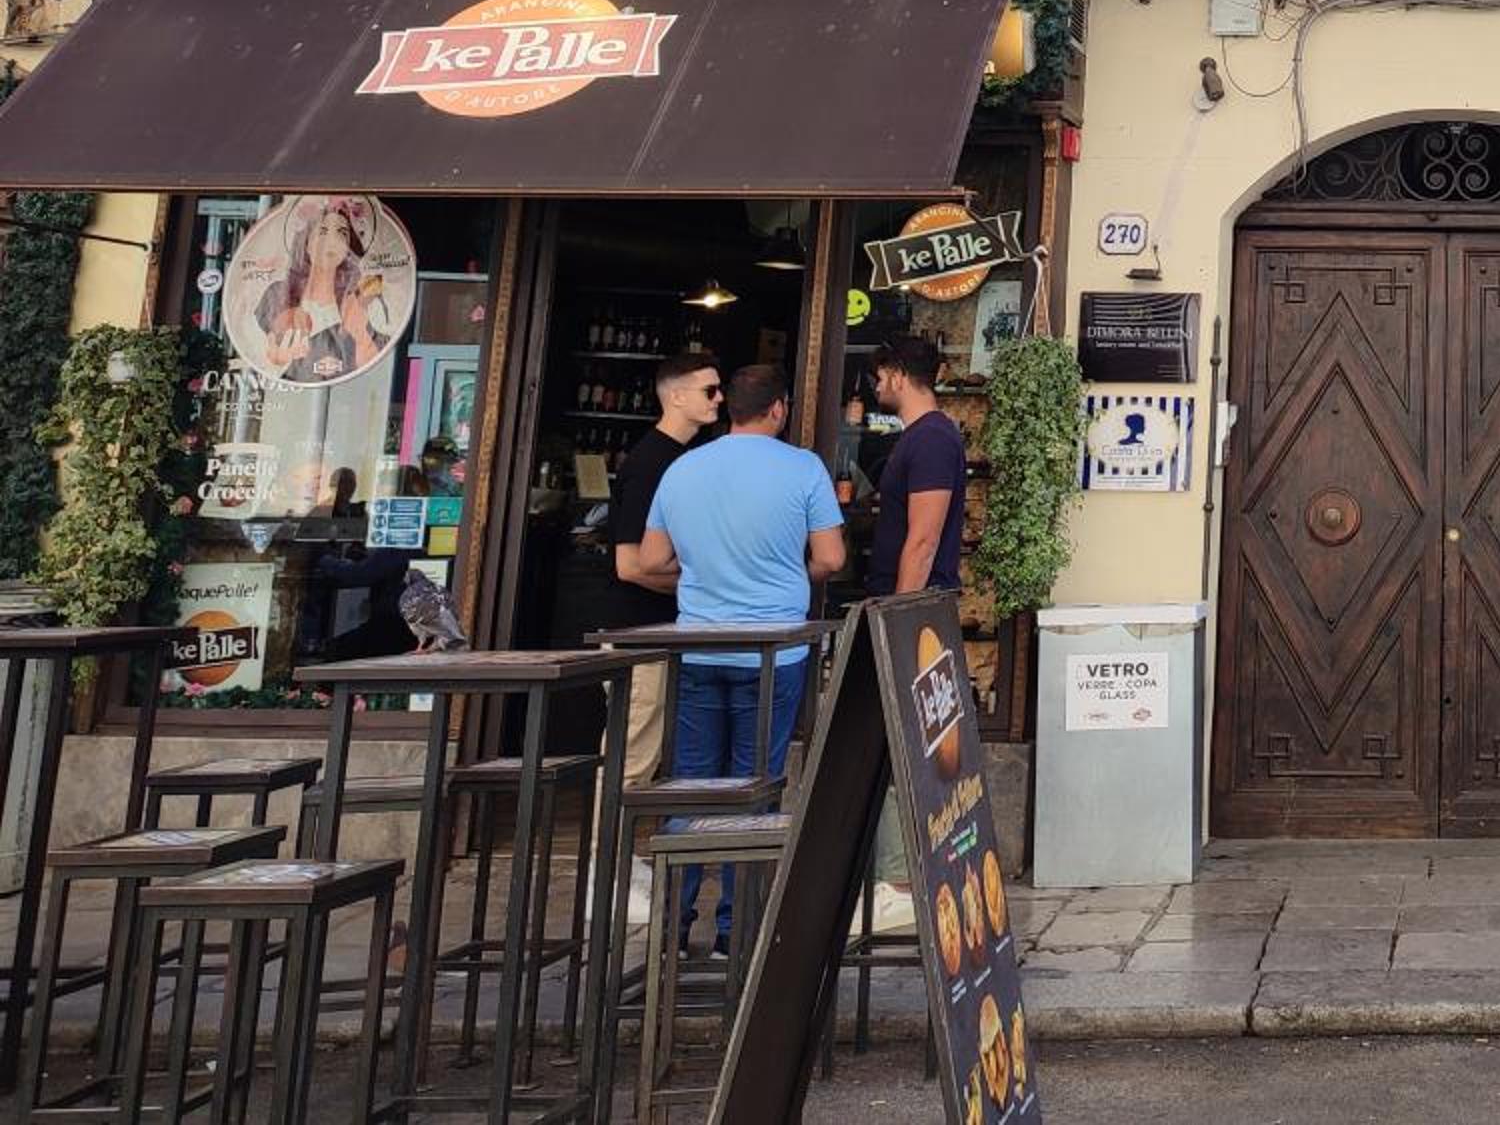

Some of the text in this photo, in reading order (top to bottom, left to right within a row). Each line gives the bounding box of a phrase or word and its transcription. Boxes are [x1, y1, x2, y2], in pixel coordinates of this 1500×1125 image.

[1104, 224, 1141, 244] 270
[198, 632, 247, 664] Palle
[1087, 662, 1149, 678] VETRO
[1077, 678, 1157, 690] VERRE COPA
[1099, 690, 1136, 700] GLASS
